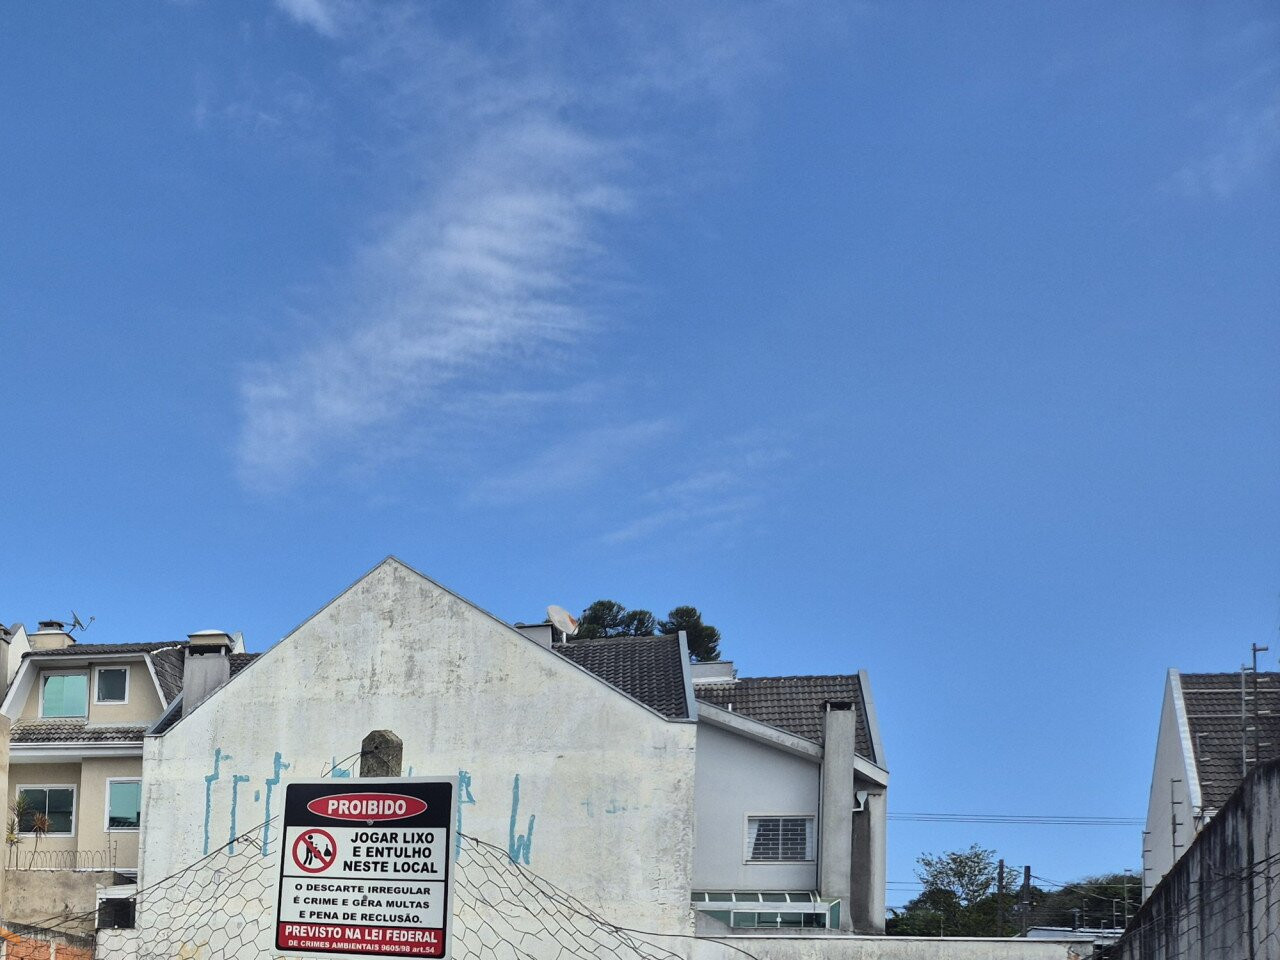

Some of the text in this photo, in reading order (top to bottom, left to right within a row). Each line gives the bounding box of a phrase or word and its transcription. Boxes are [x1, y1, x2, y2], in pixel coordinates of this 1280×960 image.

[328, 800, 407, 815] PROIBIDO
[351, 832, 434, 844] JOGAR LIXO
[353, 847, 431, 858] E ENTULHO
[343, 861, 438, 873] NESTE LOCAL
[306, 884, 364, 893] DESCARTE
[368, 886, 431, 895] IRREGULAR
[294, 895, 300, 904] É
[304, 897, 338, 906] CRIME
[386, 901, 430, 909] MULTAS
[310, 912, 339, 920] PENA
[361, 913, 422, 923] RECLUSÃO.
[285, 926, 438, 943] PREVISTO NA LEI FEDERAL
[332, 943, 379, 951] AMBIENTAIS
[381, 945, 410, 953] 9605/98
